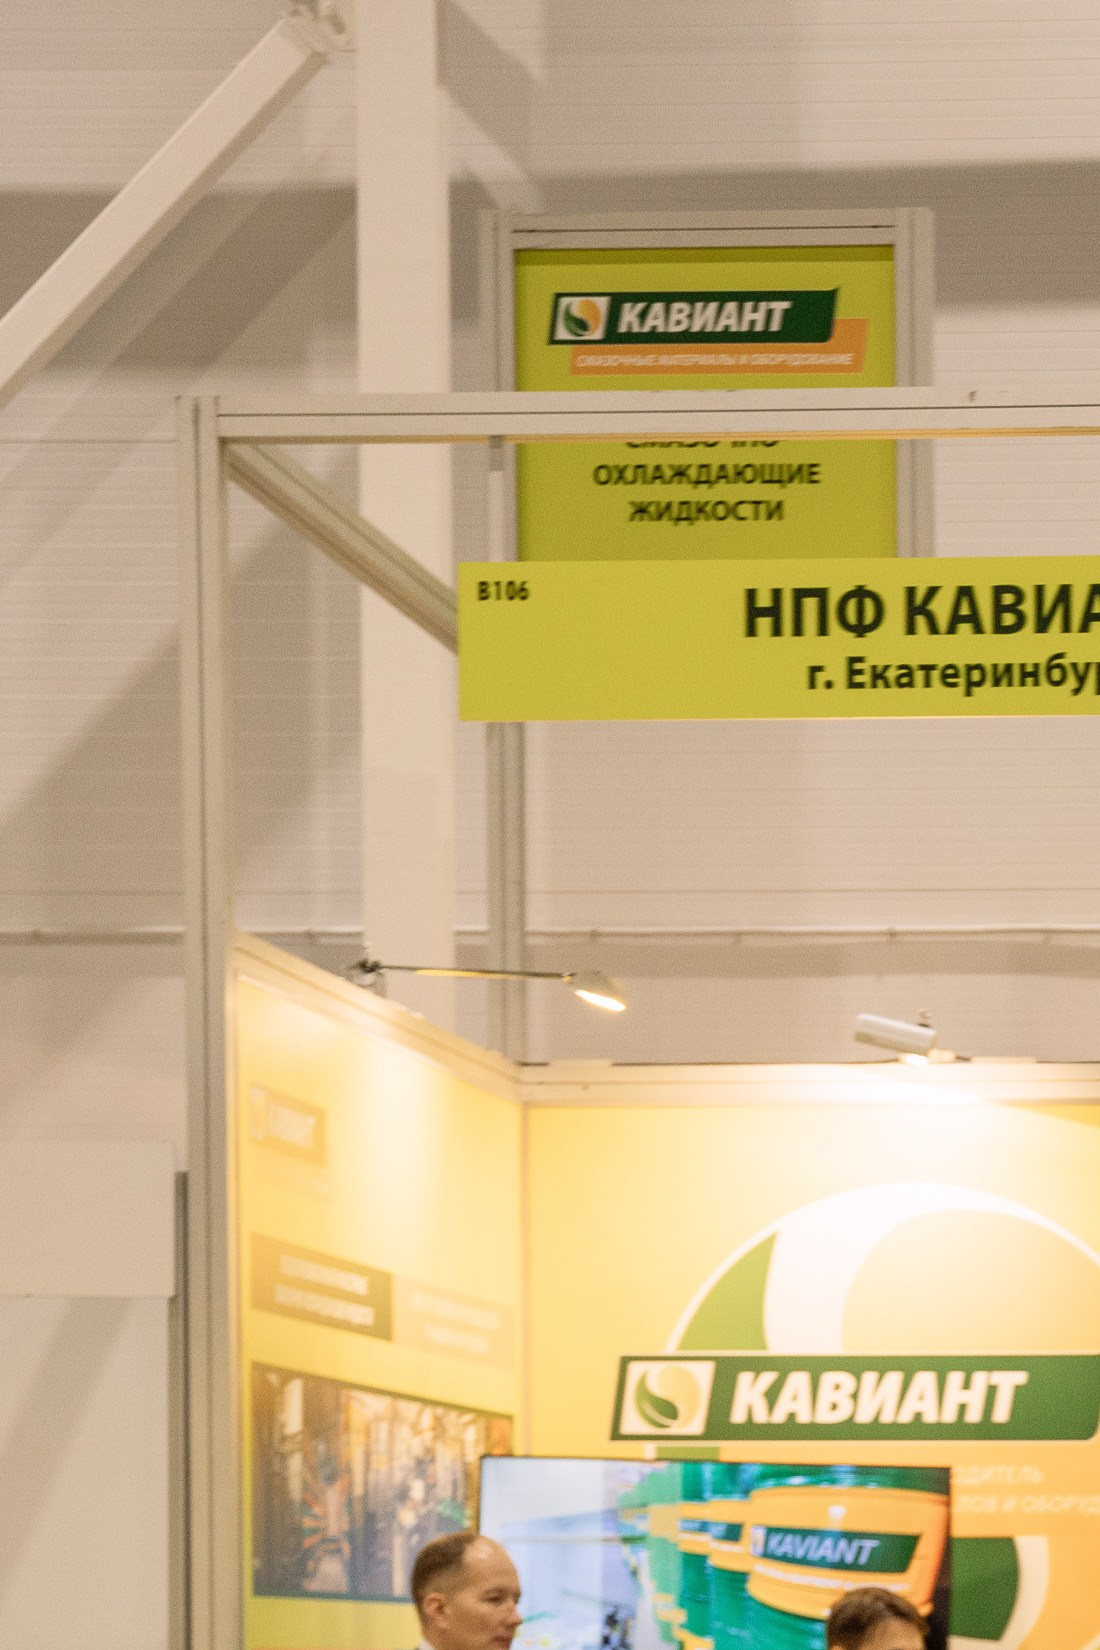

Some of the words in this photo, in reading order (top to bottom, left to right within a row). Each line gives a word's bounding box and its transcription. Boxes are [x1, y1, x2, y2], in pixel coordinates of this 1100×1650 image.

[616, 300, 793, 333] КАВИАНТ
[593, 462, 822, 489] ОХЛАЖДАЮЩИЕ
[628, 500, 785, 525] ЖИДКОСТИ
[744, 584, 886, 639] НПФ
[807, 664, 834, 691] г.
[728, 1369, 1030, 1425] КАВИАНТ
[766, 1532, 881, 1566] KAVIANT
